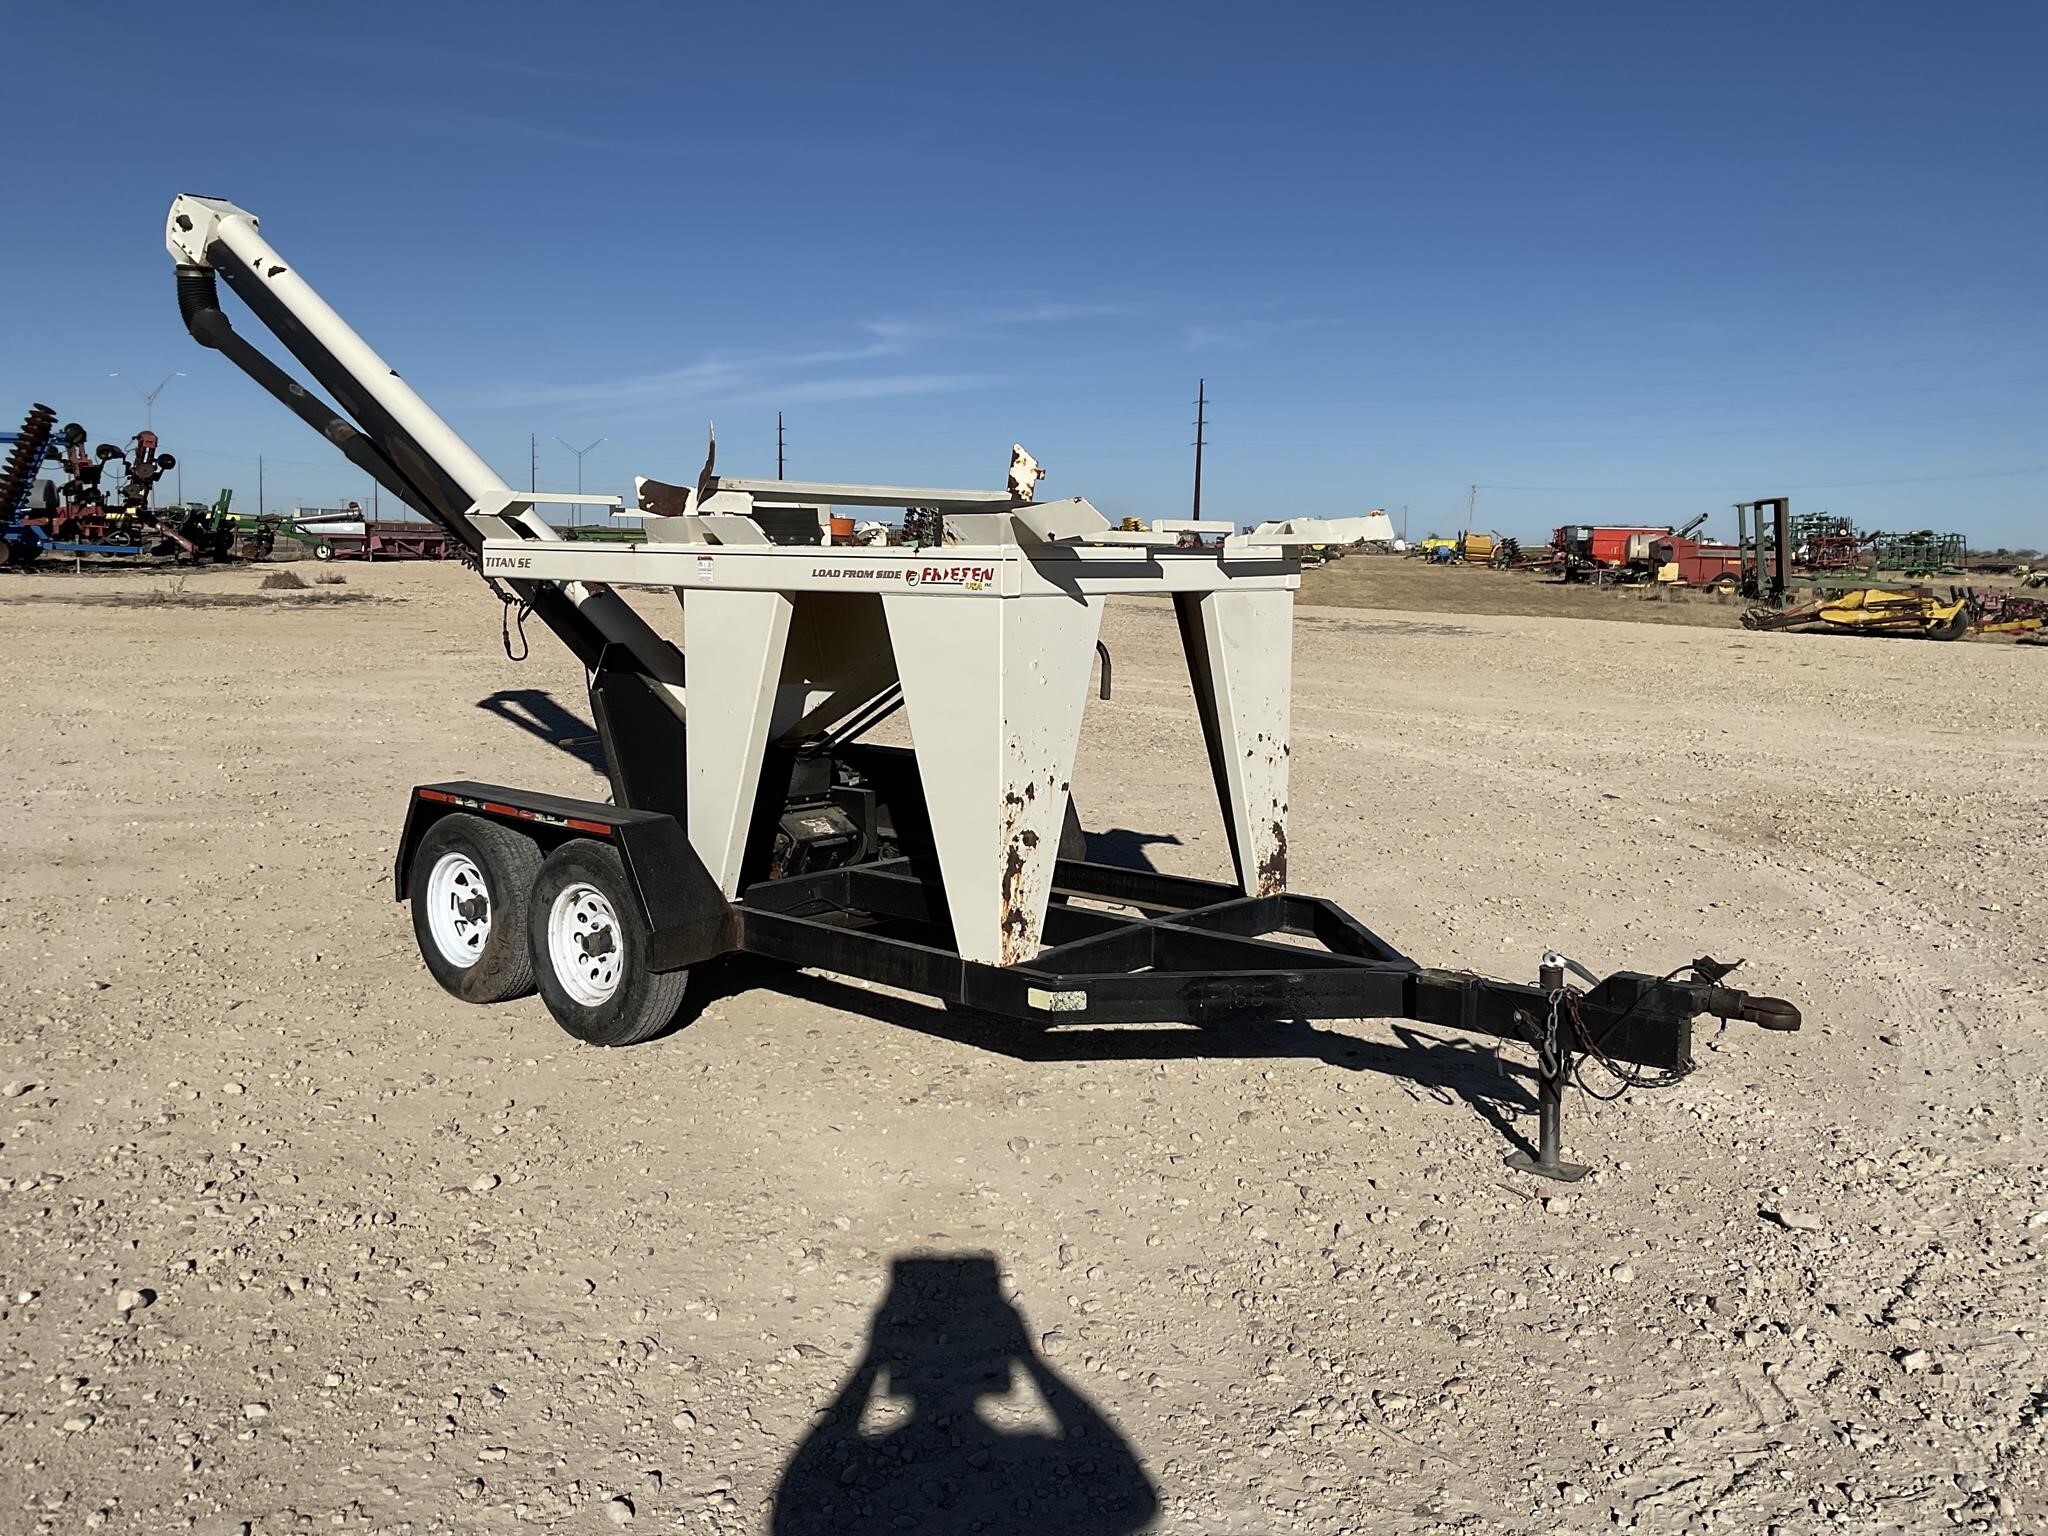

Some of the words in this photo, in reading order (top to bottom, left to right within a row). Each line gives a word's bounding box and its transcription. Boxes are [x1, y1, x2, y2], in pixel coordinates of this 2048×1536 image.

[485, 557, 516, 568] TITAN
[517, 558, 532, 569] SE
[812, 569, 841, 578] LOAD
[842, 569, 874, 579] FROM
[875, 570, 902, 579] SIDE
